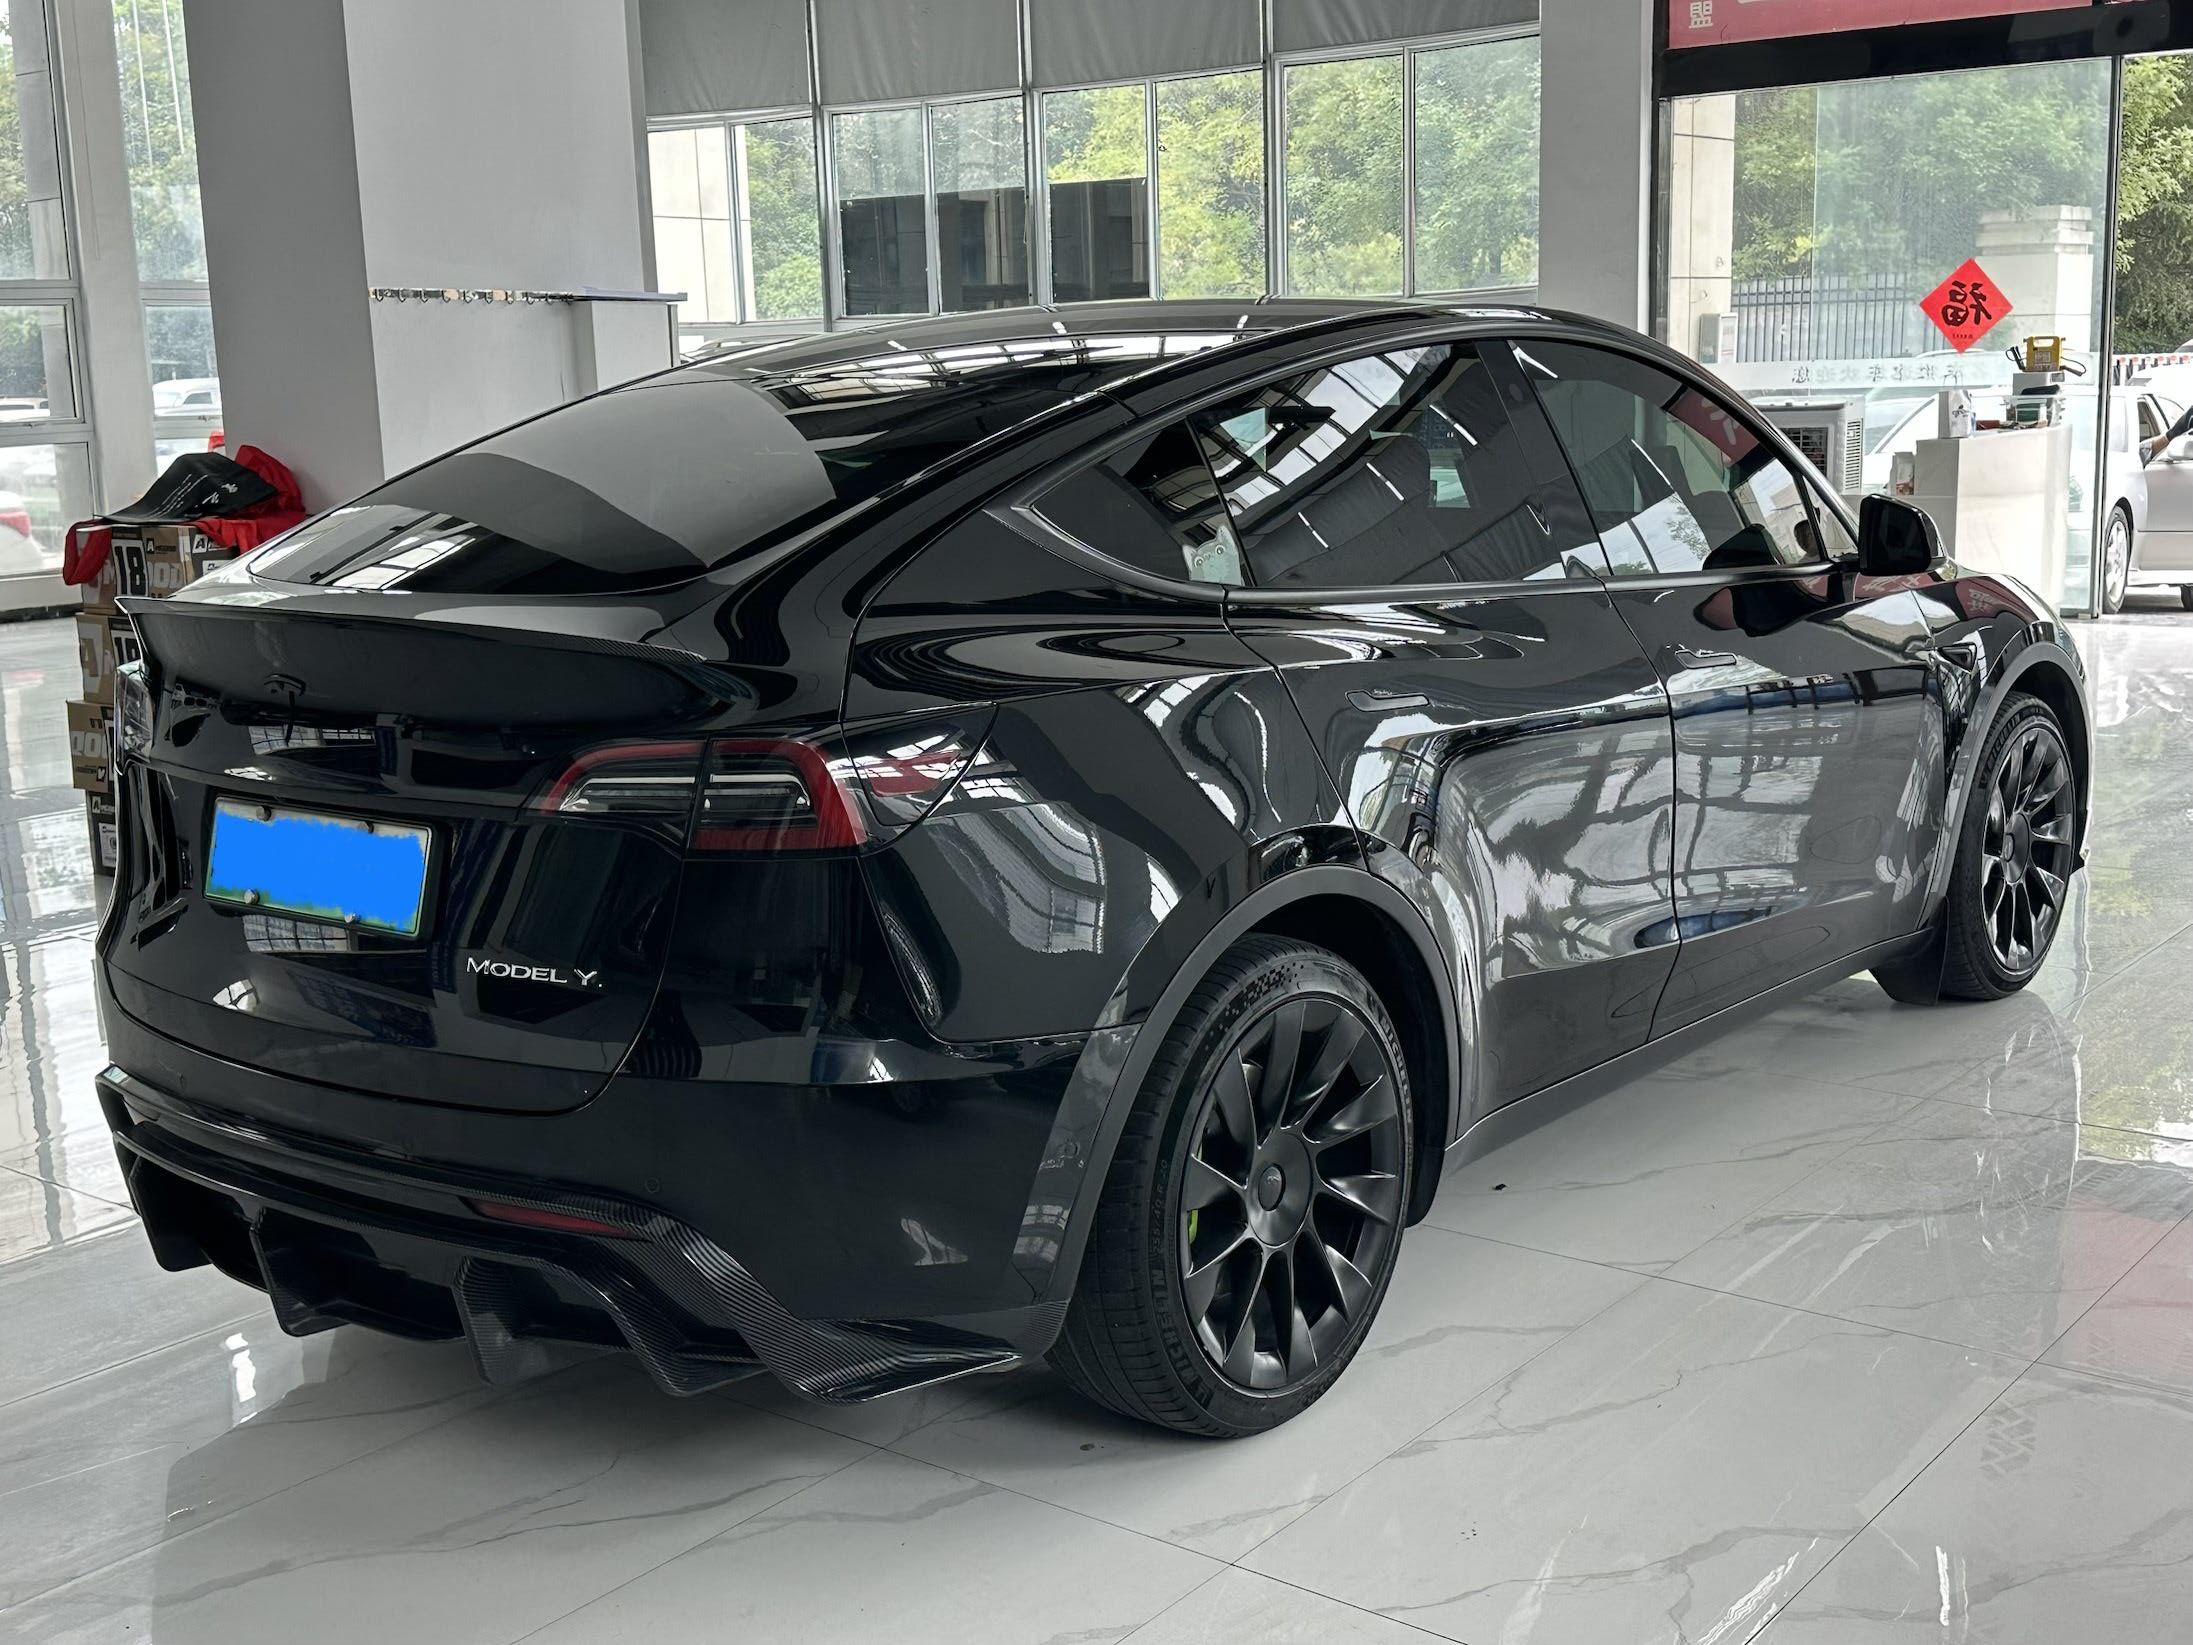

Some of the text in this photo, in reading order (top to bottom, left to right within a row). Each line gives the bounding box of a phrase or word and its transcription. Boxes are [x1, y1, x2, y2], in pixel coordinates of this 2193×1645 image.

[466, 957, 568, 984] MODEL
[1379, 1015, 1413, 1122] MICHELIN
[1152, 1268, 1201, 1390] MICHELIN
